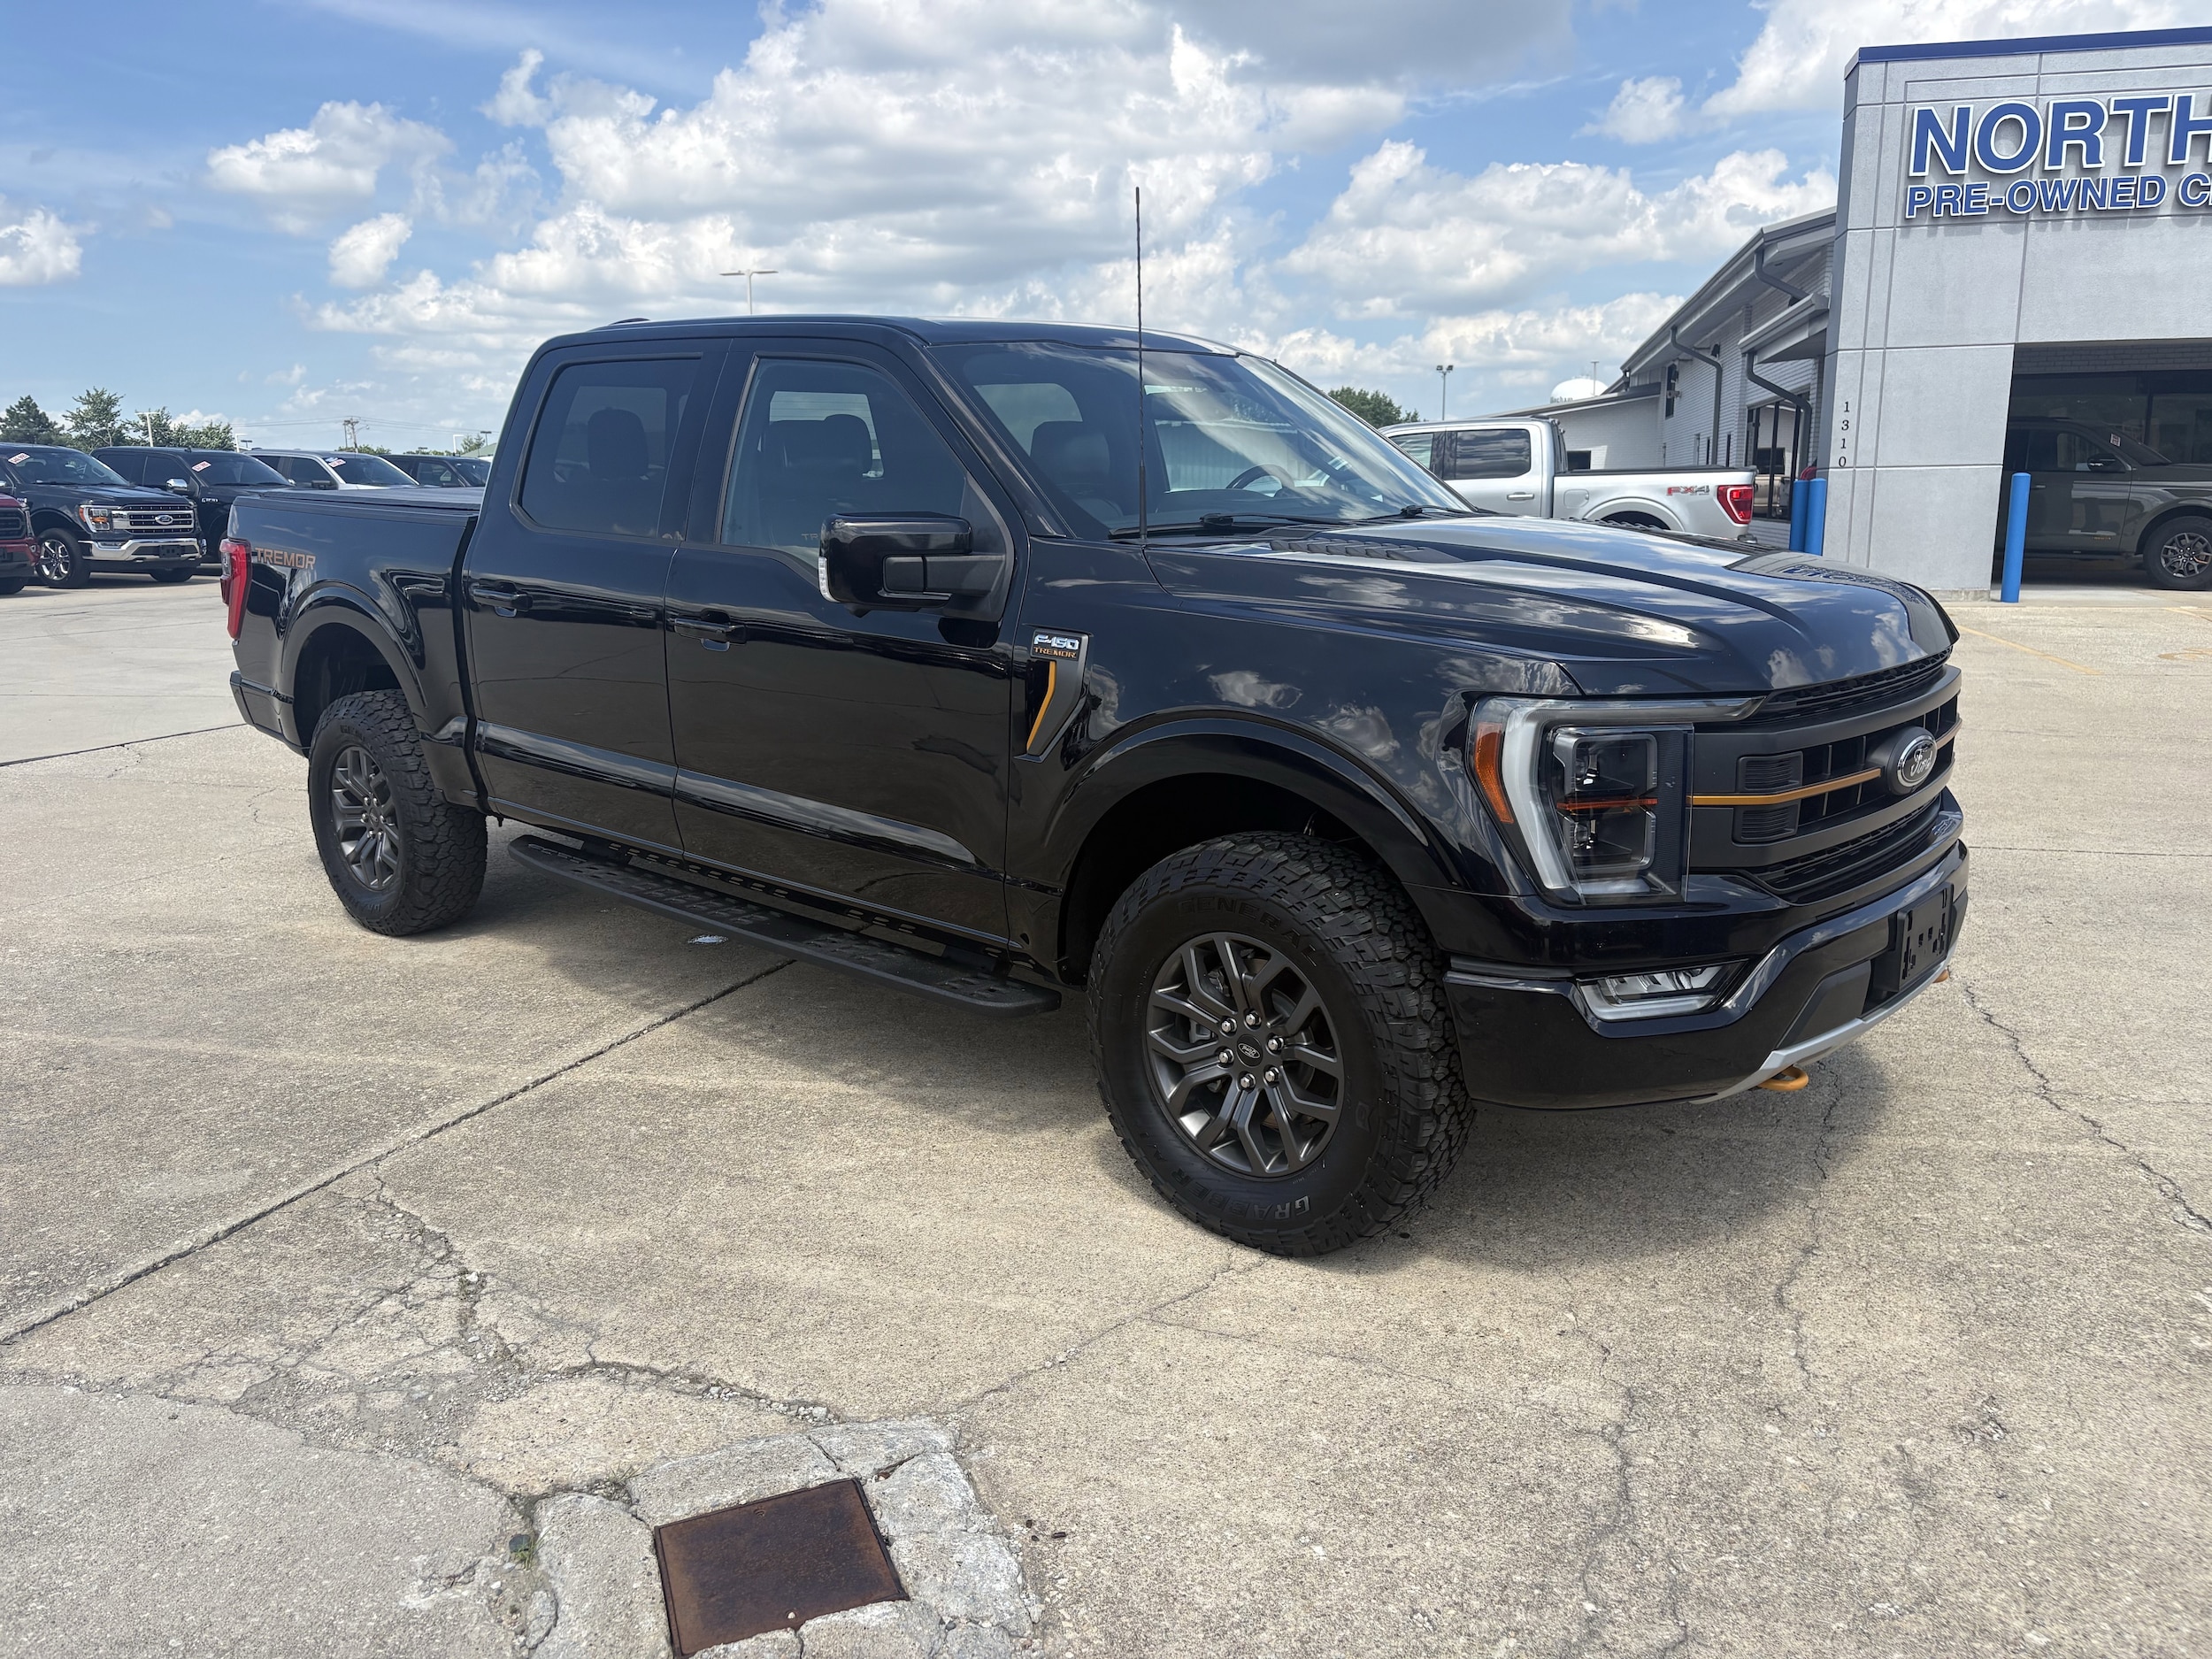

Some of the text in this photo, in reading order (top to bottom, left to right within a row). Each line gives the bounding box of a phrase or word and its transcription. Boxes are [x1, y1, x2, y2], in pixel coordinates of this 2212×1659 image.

[1909, 93, 2212, 177] NORTH
[1905, 172, 2212, 219] PRE-OWNED C
[1839, 401, 1850, 467] 1310
[1667, 485, 1709, 495] FX4
[255, 547, 316, 570] TREMOR
[1033, 634, 1079, 649] F-150
[1033, 646, 1077, 658] TREMOR
[1910, 746, 1933, 777] Ford
[1177, 895, 1317, 967] GENERAL
[1170, 1167, 1310, 1221] GRABBER
